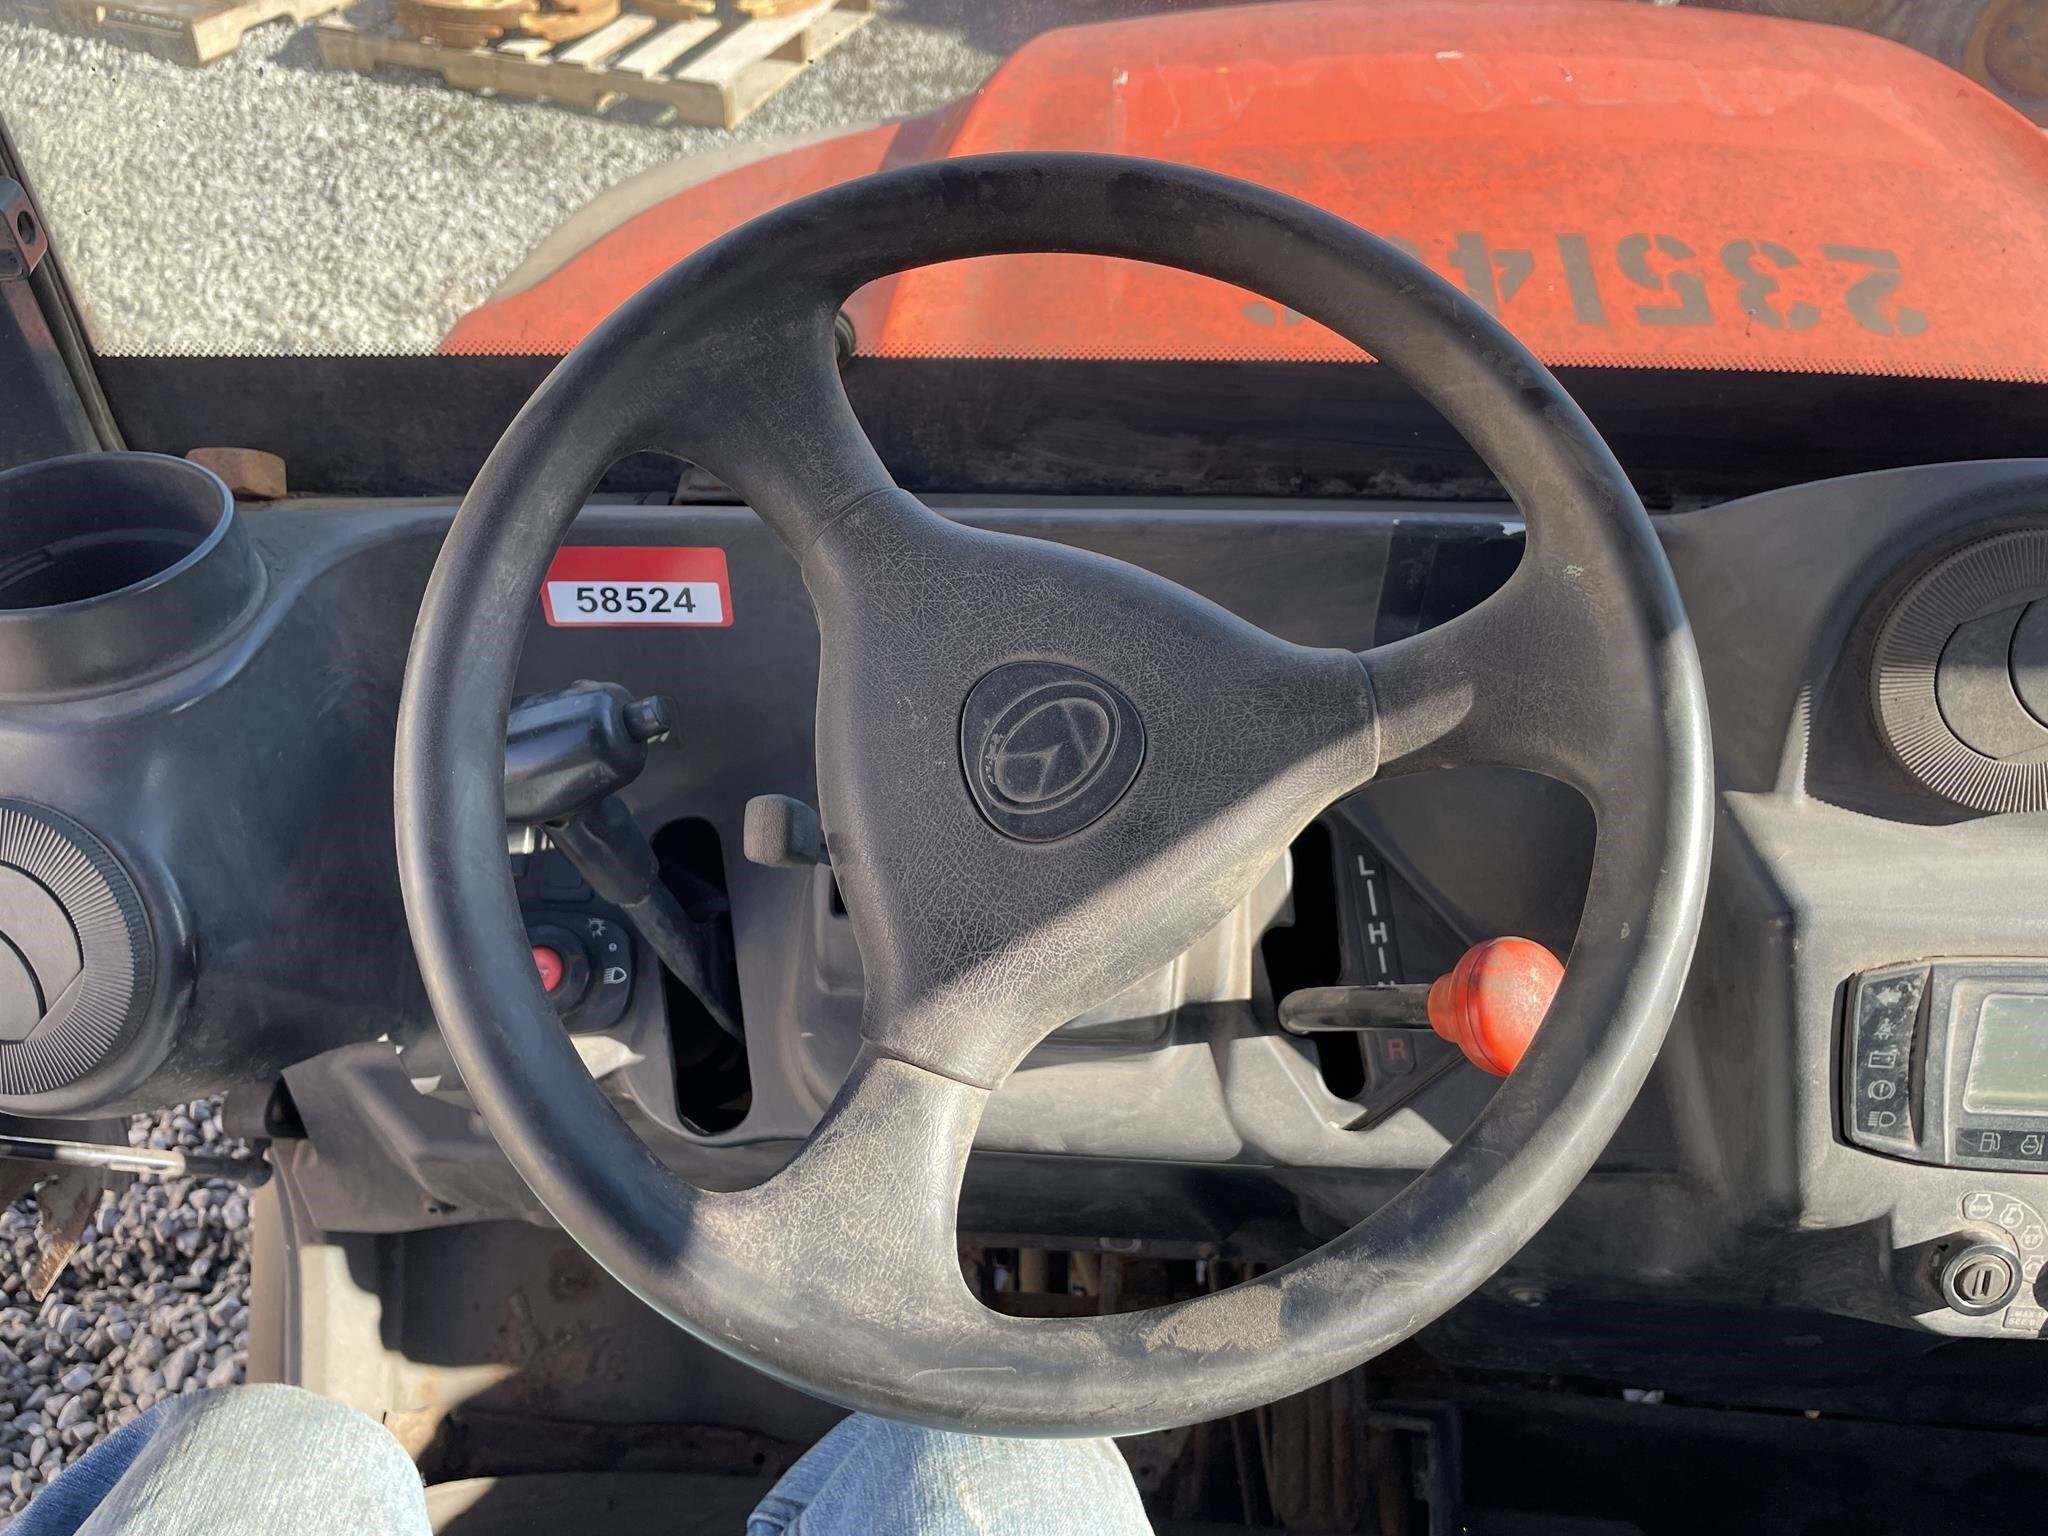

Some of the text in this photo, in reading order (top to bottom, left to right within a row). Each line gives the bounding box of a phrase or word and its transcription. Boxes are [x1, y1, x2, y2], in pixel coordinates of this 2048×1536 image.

[576, 587, 696, 613] 58524
[1357, 855, 1375, 876] L
[1367, 921, 1388, 944] H
[1387, 1039, 1406, 1060] R
